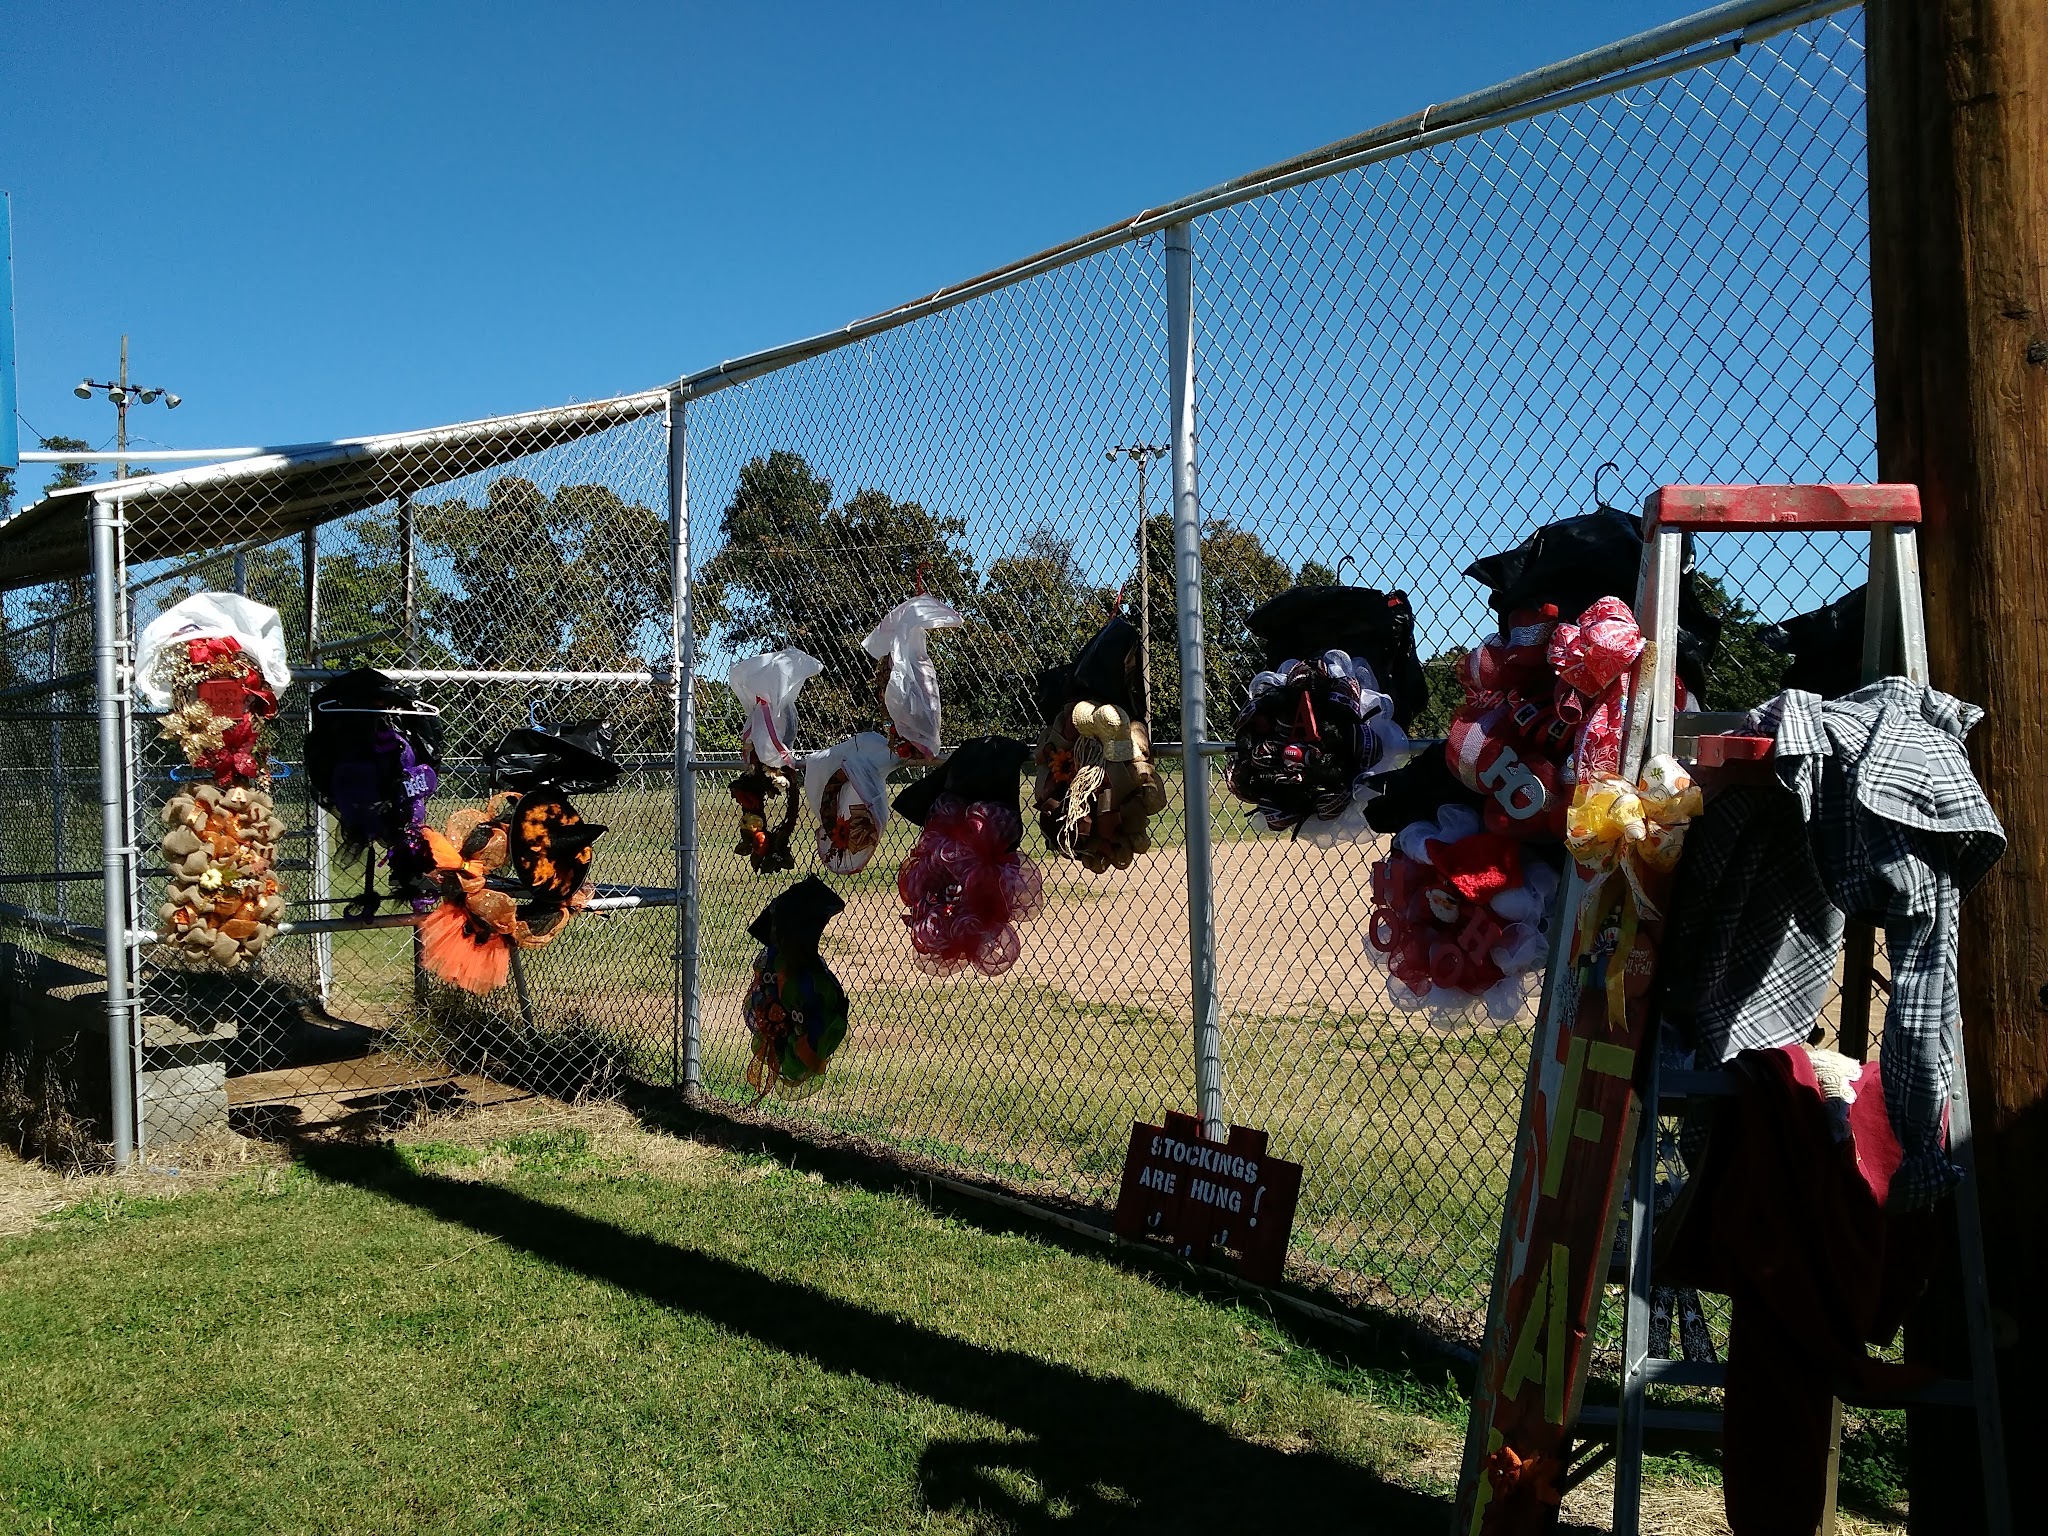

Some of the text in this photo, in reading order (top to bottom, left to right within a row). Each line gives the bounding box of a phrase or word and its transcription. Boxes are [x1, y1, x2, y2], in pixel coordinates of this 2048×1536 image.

[1152, 1136, 1259, 1184] STOCKINGS
[1139, 1166, 1177, 1194] ARE
[1190, 1178, 1242, 1213] HUNG
